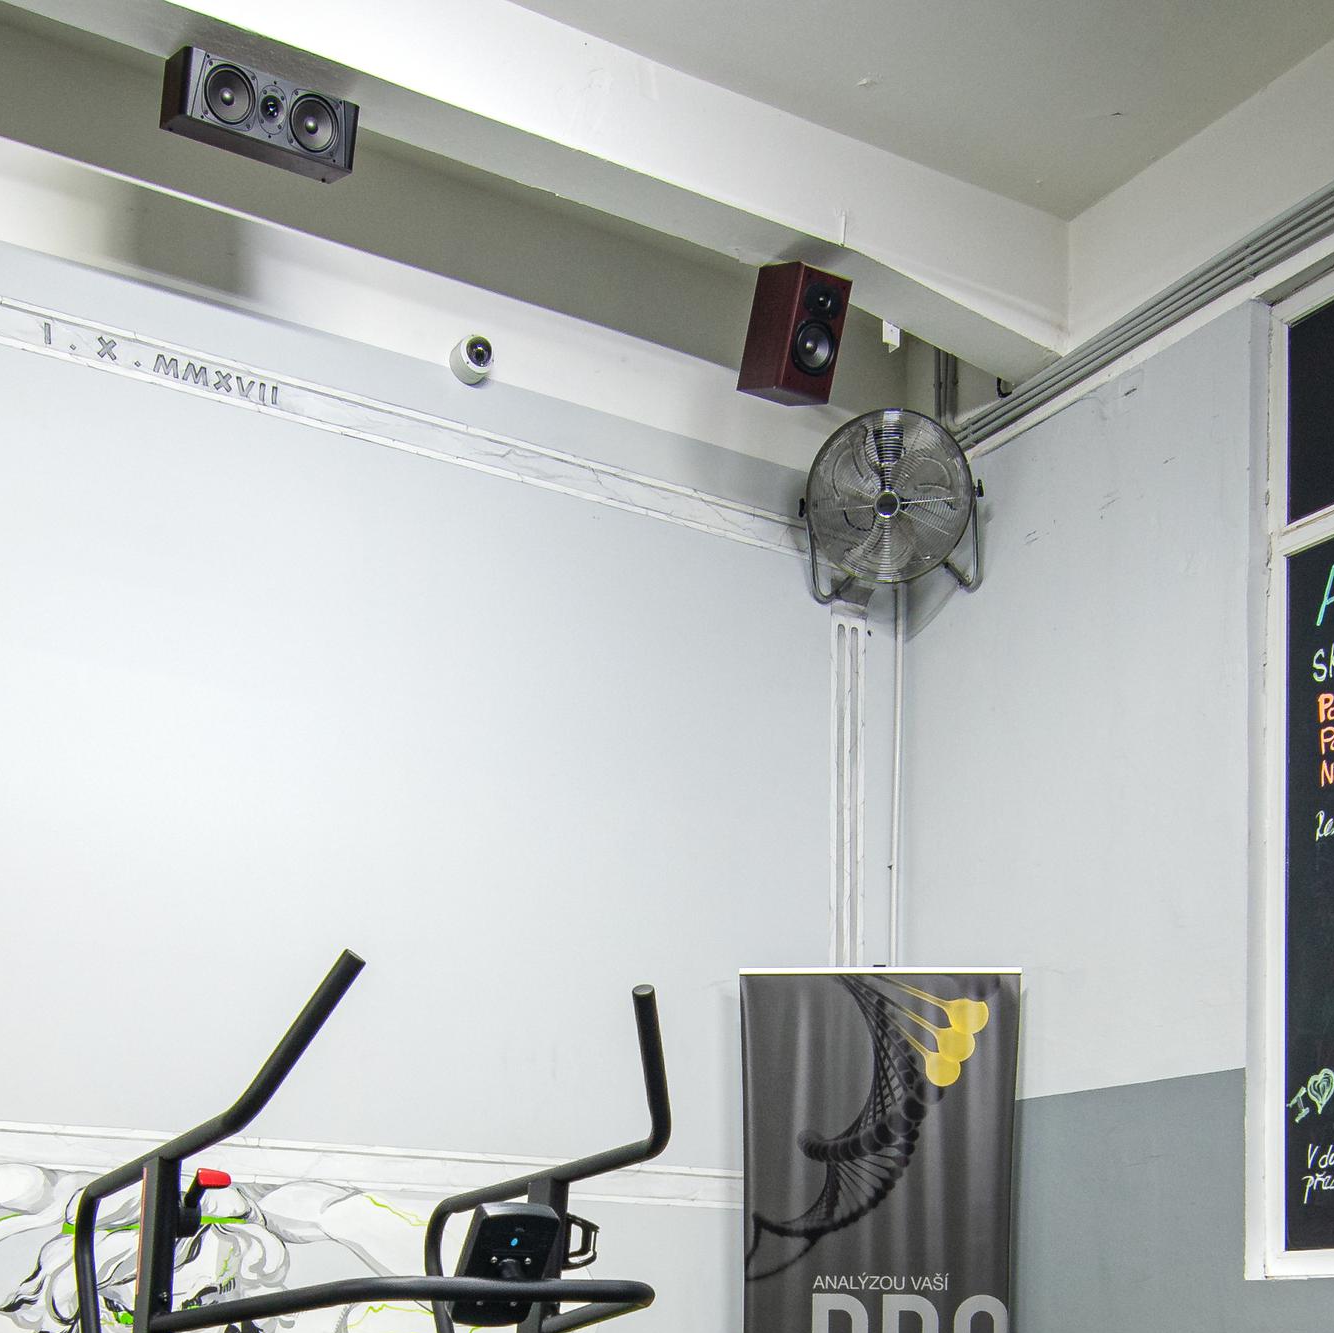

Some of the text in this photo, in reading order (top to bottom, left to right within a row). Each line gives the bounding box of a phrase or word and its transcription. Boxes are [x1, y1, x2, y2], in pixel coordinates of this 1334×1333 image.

[153, 354, 278, 405] MMXVII
[812, 1272, 949, 1291] ANALÝZOU VAŠÍ
